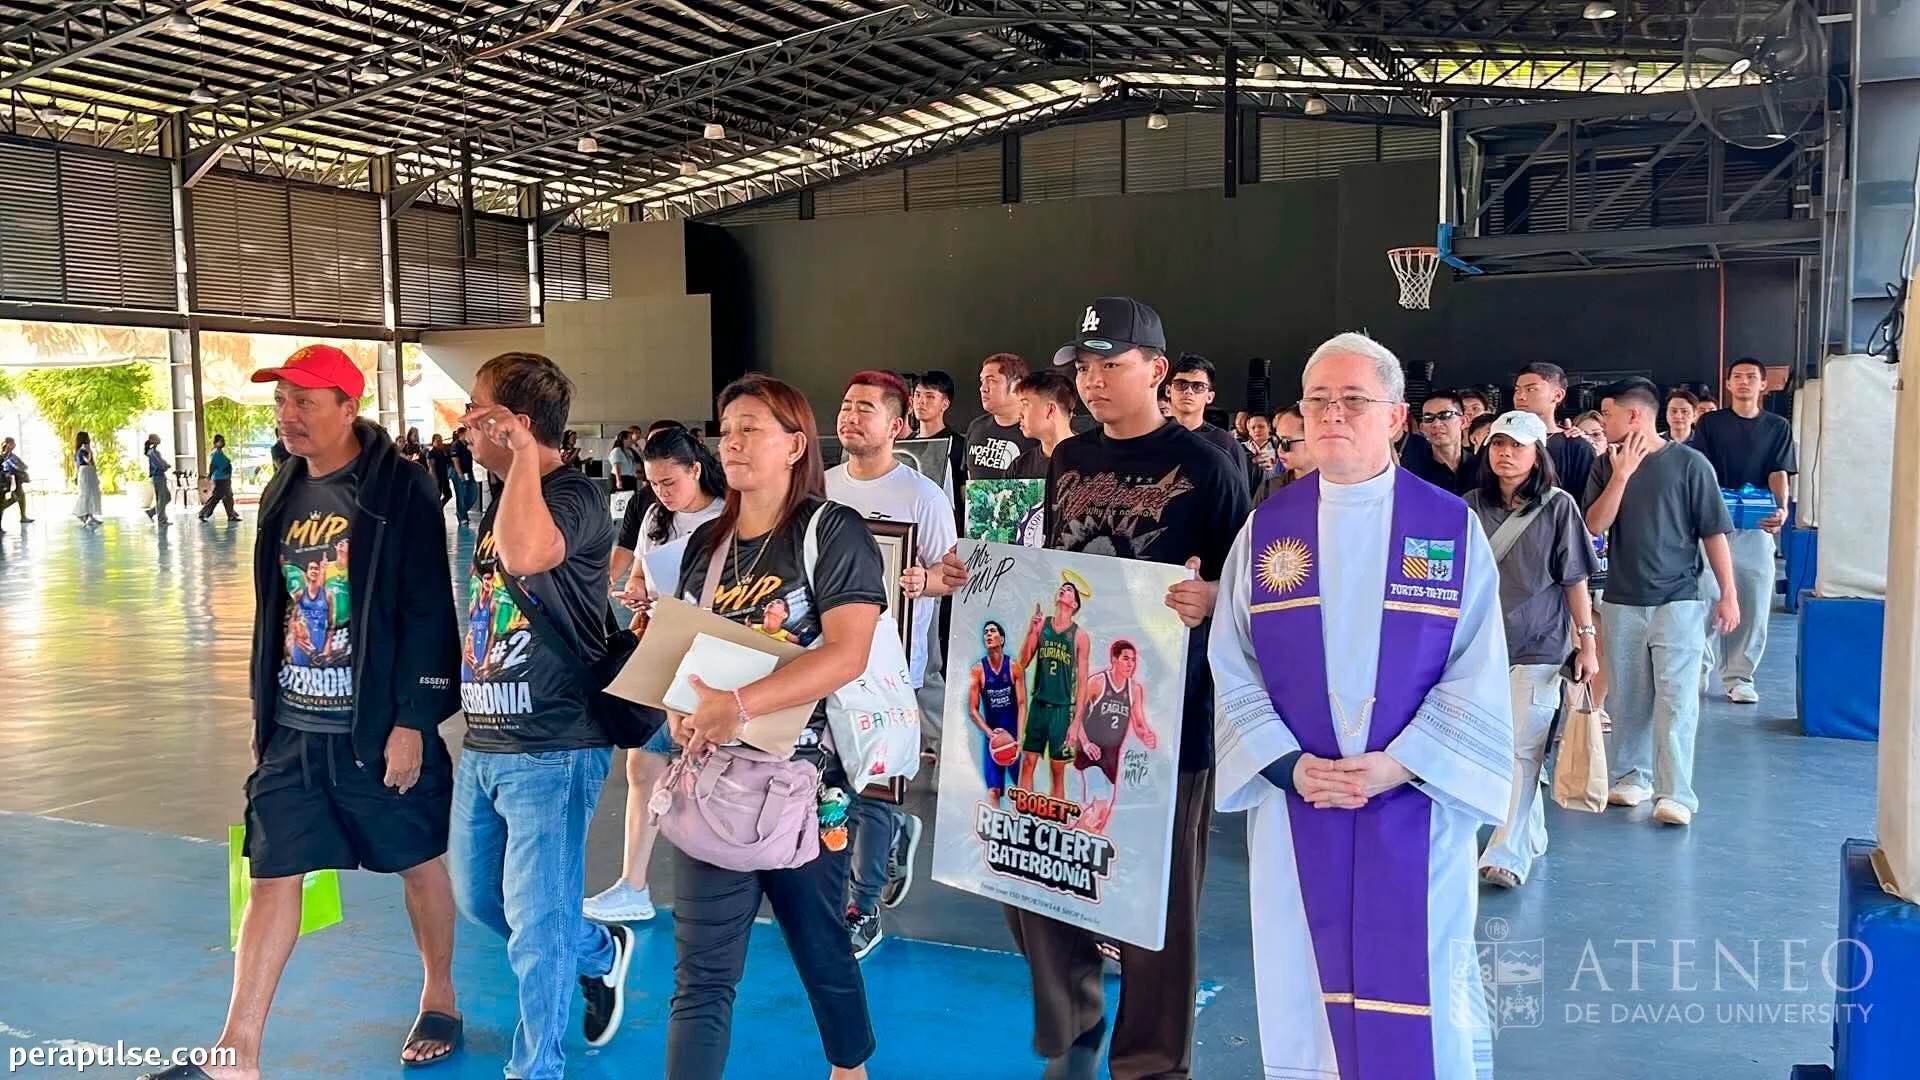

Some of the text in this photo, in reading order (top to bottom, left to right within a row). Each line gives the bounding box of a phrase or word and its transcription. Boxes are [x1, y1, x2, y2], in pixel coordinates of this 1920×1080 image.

[1081, 305, 1100, 332] LA
[969, 445, 1004, 459] NORTH
[986, 437, 1006, 451] THE
[974, 456, 1001, 470] FACE
[285, 512, 348, 546] MVP
[963, 556, 1016, 608] MVP
[714, 574, 783, 613] MVP
[490, 630, 532, 669] #2
[1050, 660, 1057, 676] 2
[1101, 702, 1130, 716] EAGLES
[1111, 715, 1119, 730] 2
[977, 805, 1109, 867] RENE CLERT
